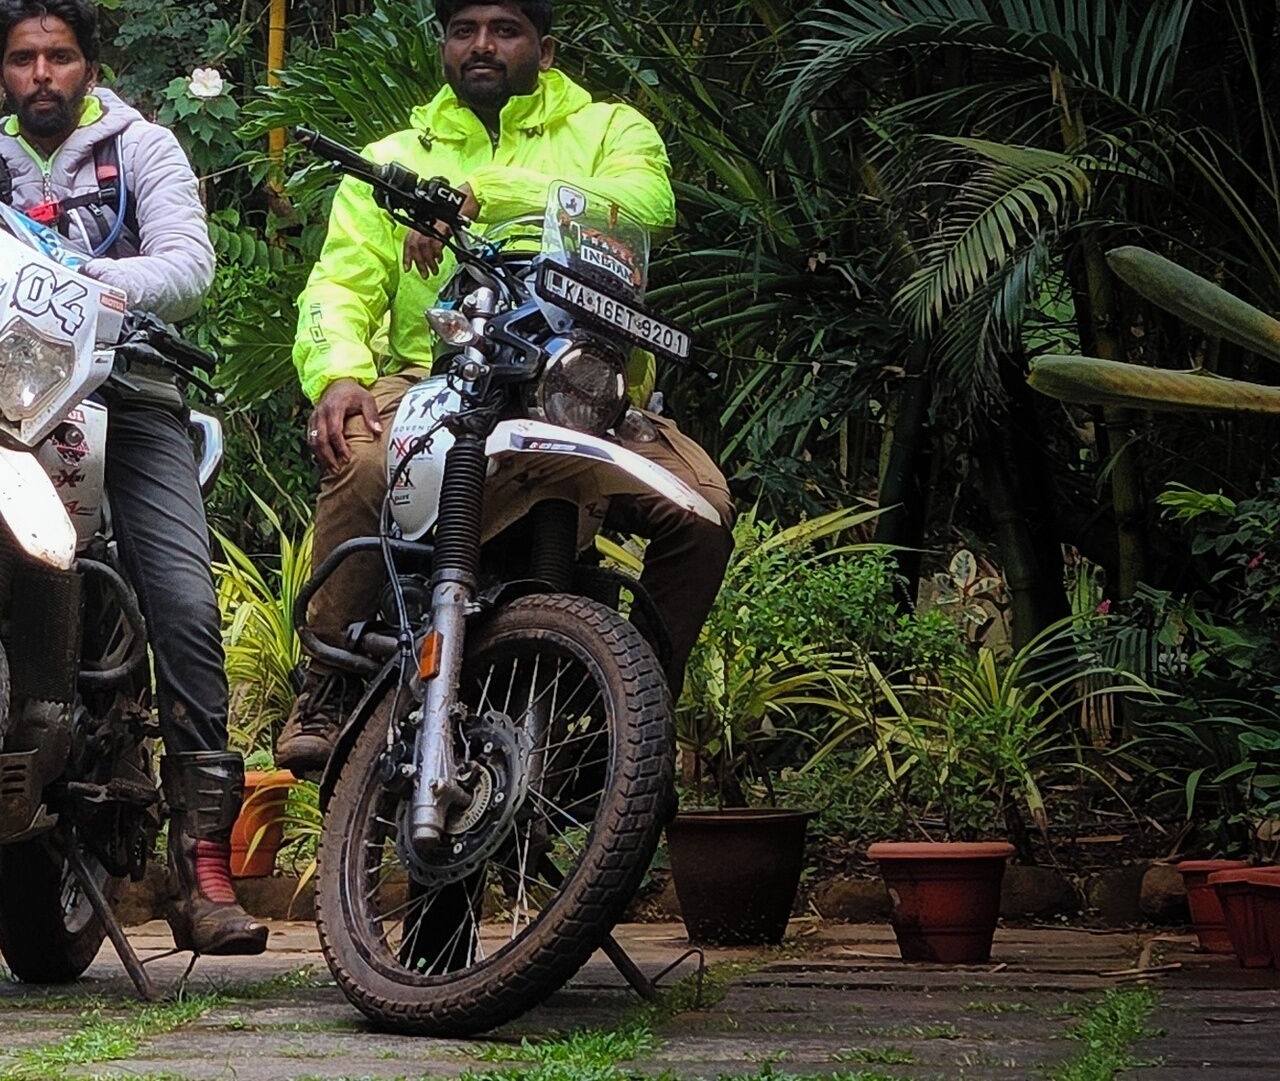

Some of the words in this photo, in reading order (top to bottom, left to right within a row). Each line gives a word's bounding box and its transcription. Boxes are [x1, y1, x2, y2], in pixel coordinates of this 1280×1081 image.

[14, 262, 88, 336] 04
[565, 280, 585, 308] KA
[596, 296, 635, 330] 16ET
[641, 319, 683, 354] 9201
